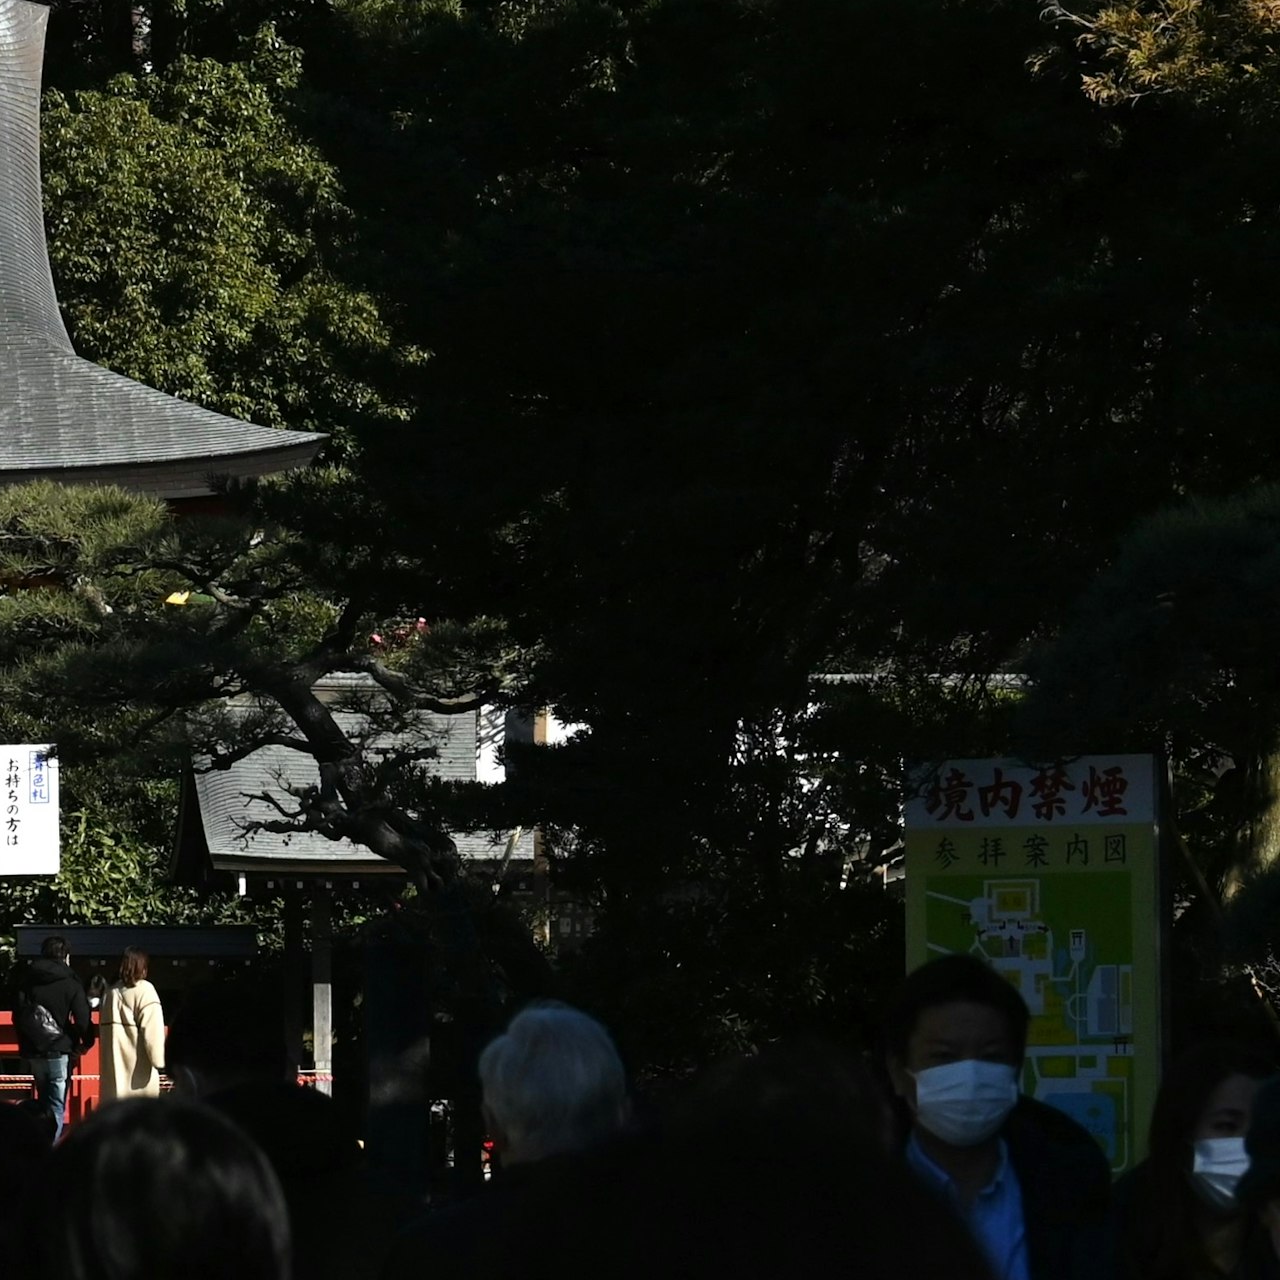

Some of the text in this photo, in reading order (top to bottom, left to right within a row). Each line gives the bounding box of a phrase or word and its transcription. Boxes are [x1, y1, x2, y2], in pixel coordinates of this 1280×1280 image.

[5, 758, 21, 846] お持ちの方は
[926, 765, 1128, 821] 境内禁煙
[935, 833, 1126, 869] 参拝案内図
